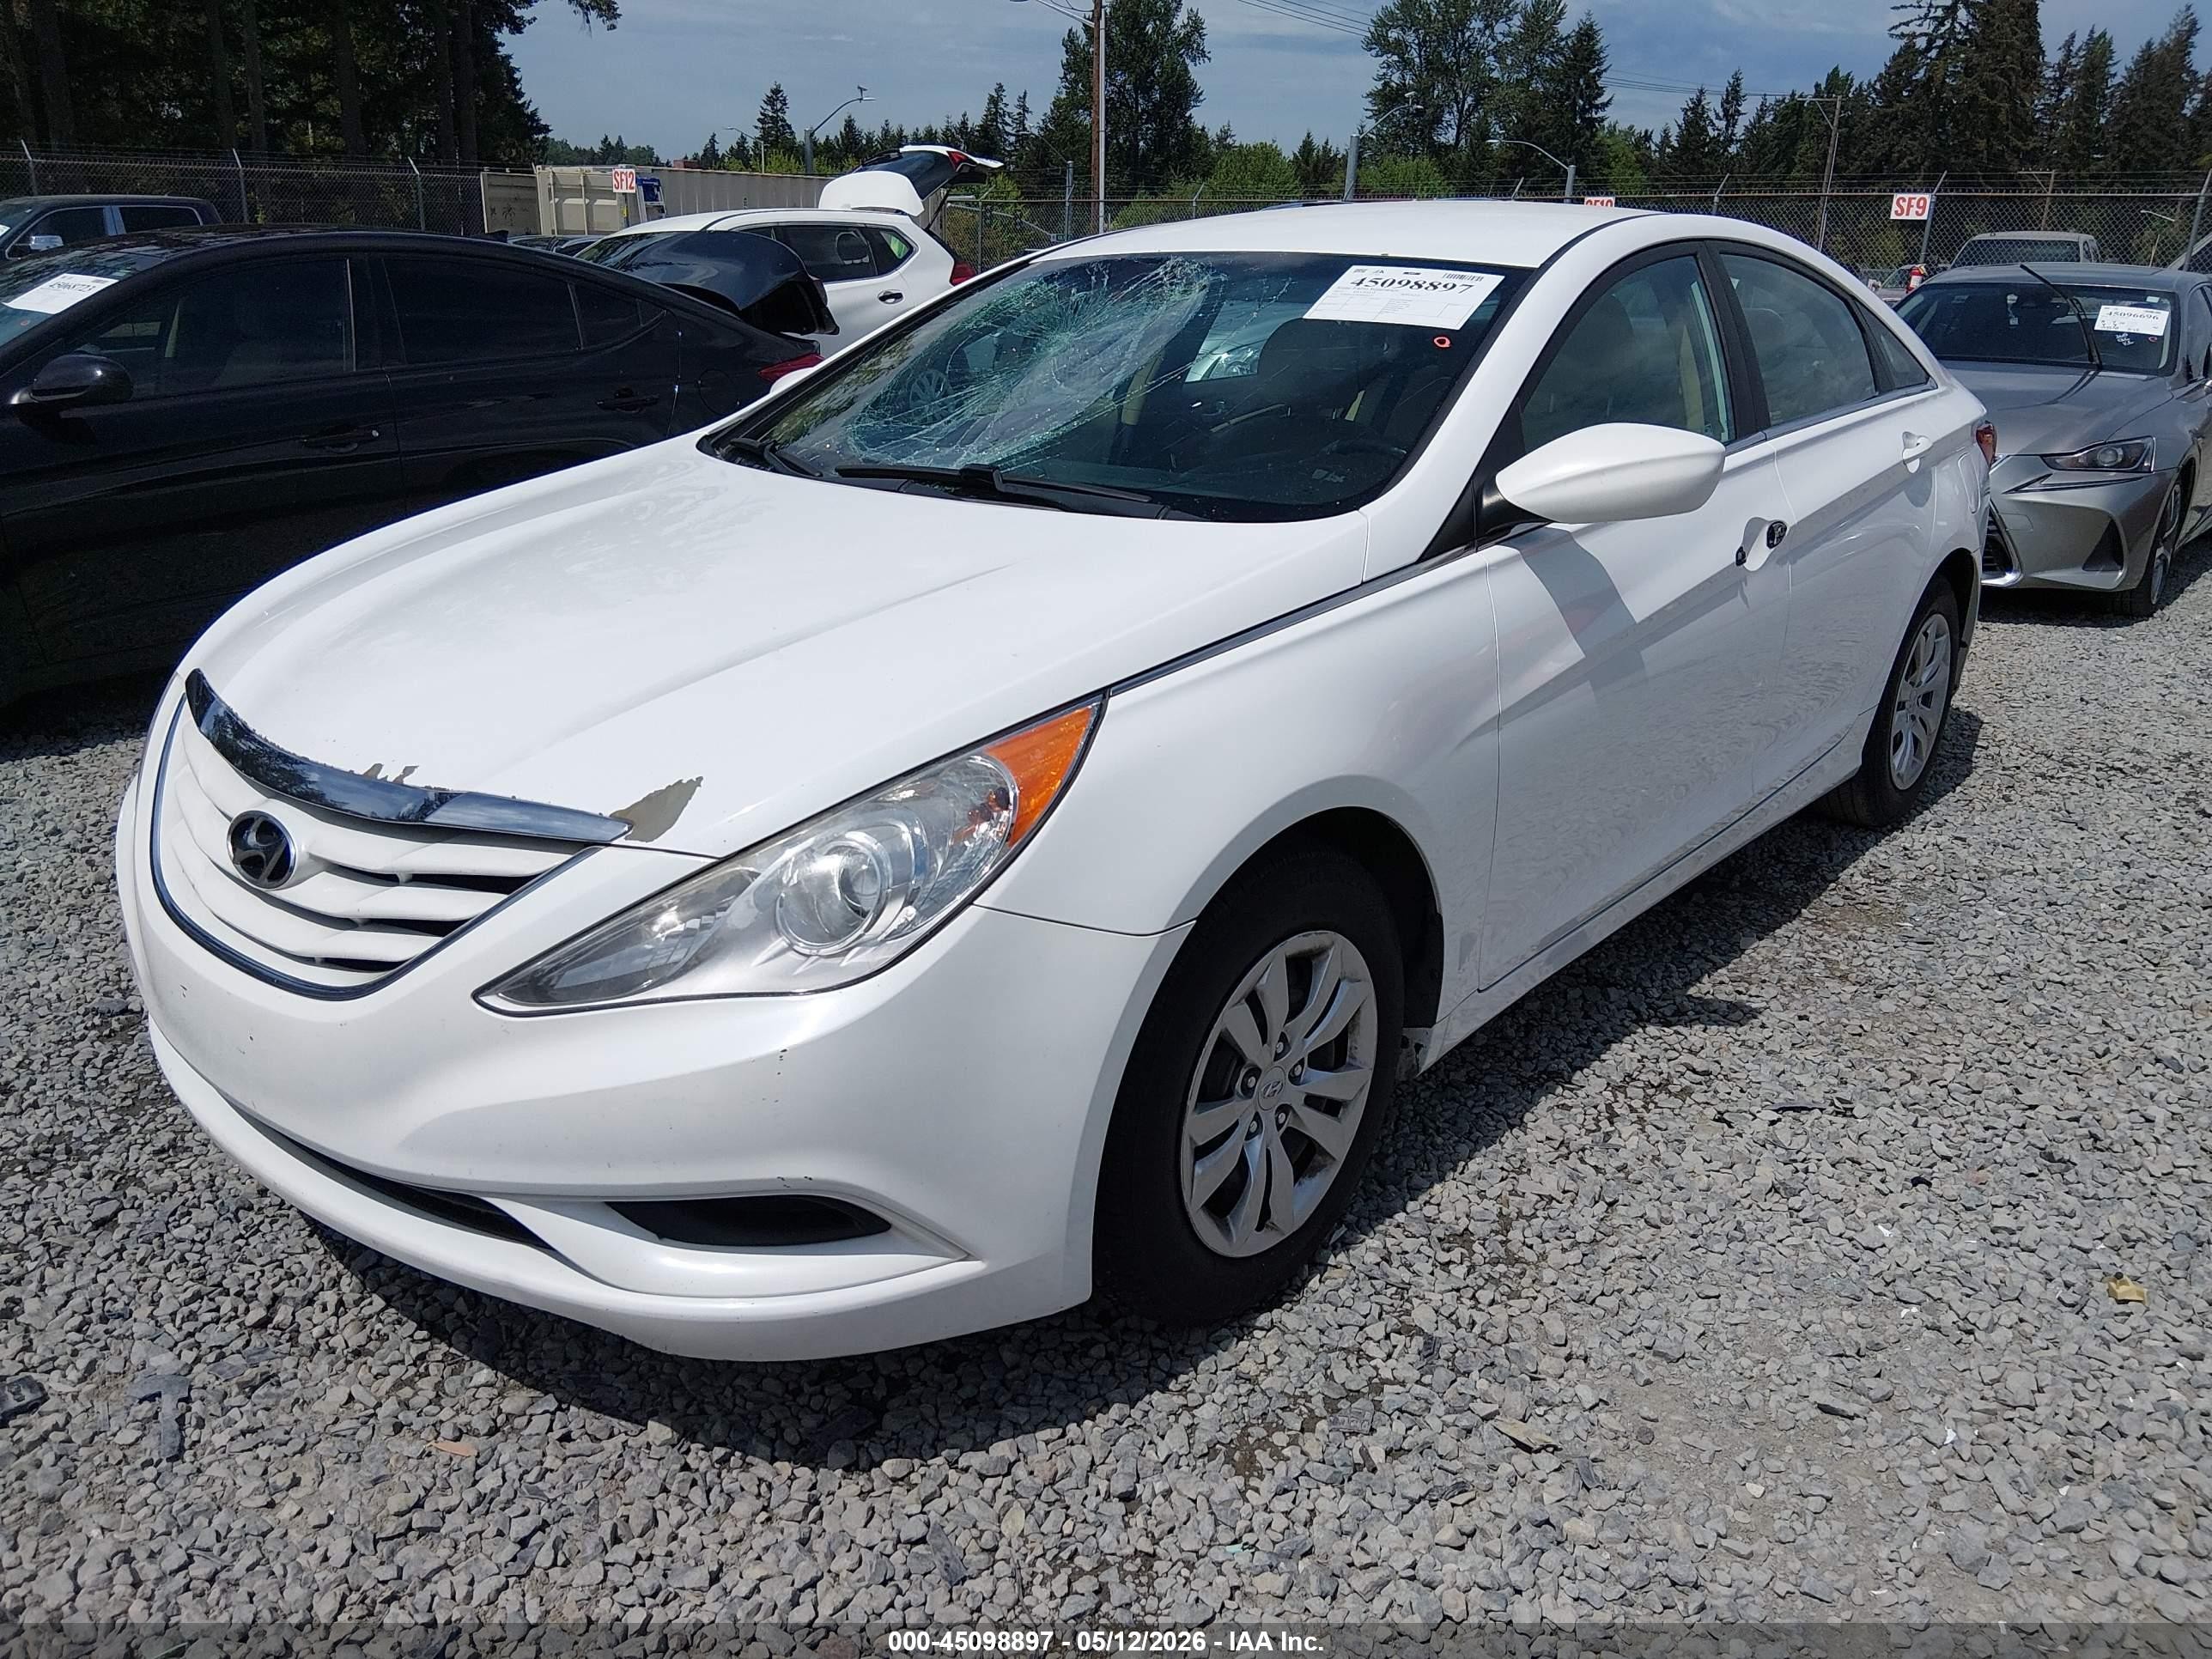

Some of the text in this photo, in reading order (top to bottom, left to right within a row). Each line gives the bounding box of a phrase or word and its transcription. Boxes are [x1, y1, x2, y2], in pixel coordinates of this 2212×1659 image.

[614, 171, 635, 190] SF12
[1894, 197, 1928, 216] SF9
[1350, 276, 1475, 295] 45098897
[2106, 311, 2160, 320] 45096696
